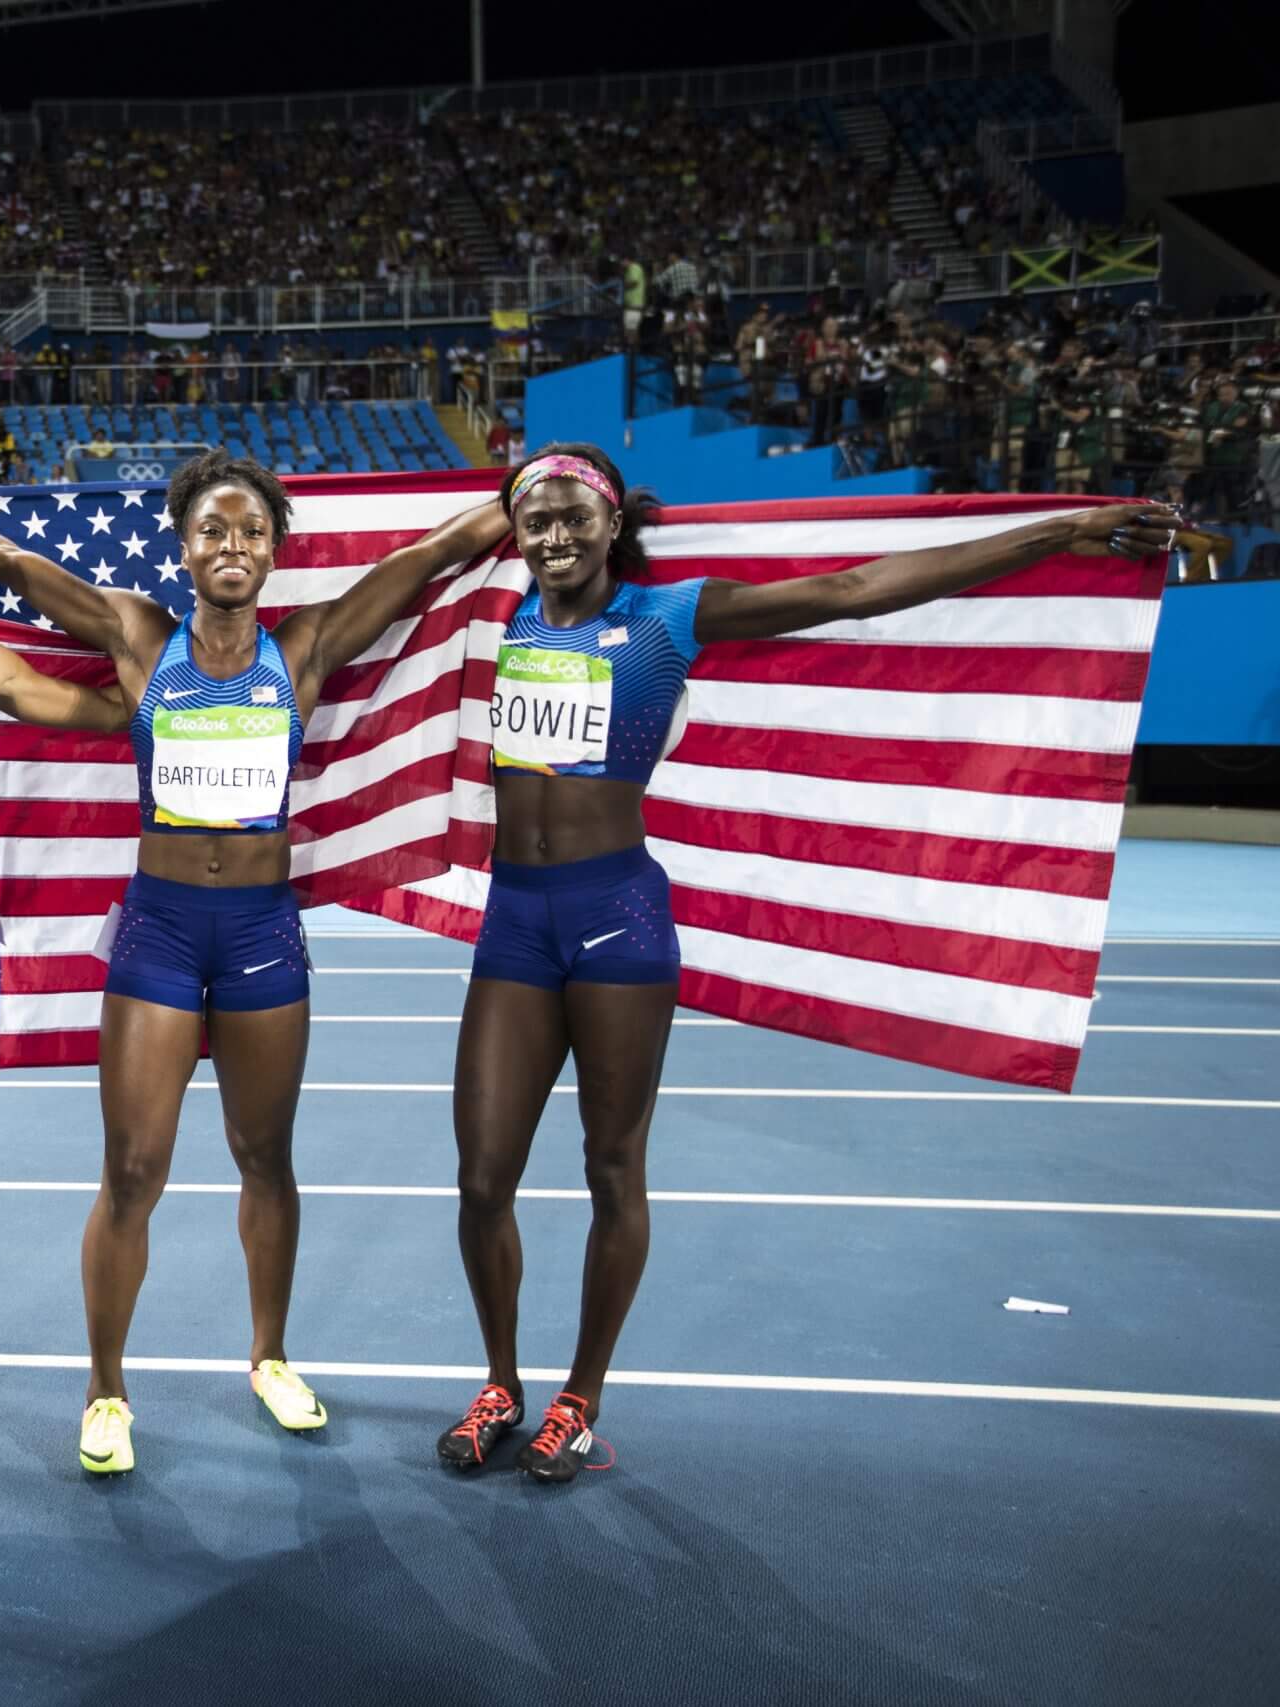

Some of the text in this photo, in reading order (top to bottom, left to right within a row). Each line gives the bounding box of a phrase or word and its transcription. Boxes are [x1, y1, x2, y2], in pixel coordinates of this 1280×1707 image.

[171, 715, 229, 732] Rio2016
[489, 693, 606, 744] BOWIE
[158, 766, 276, 788] BARTOLETTA
